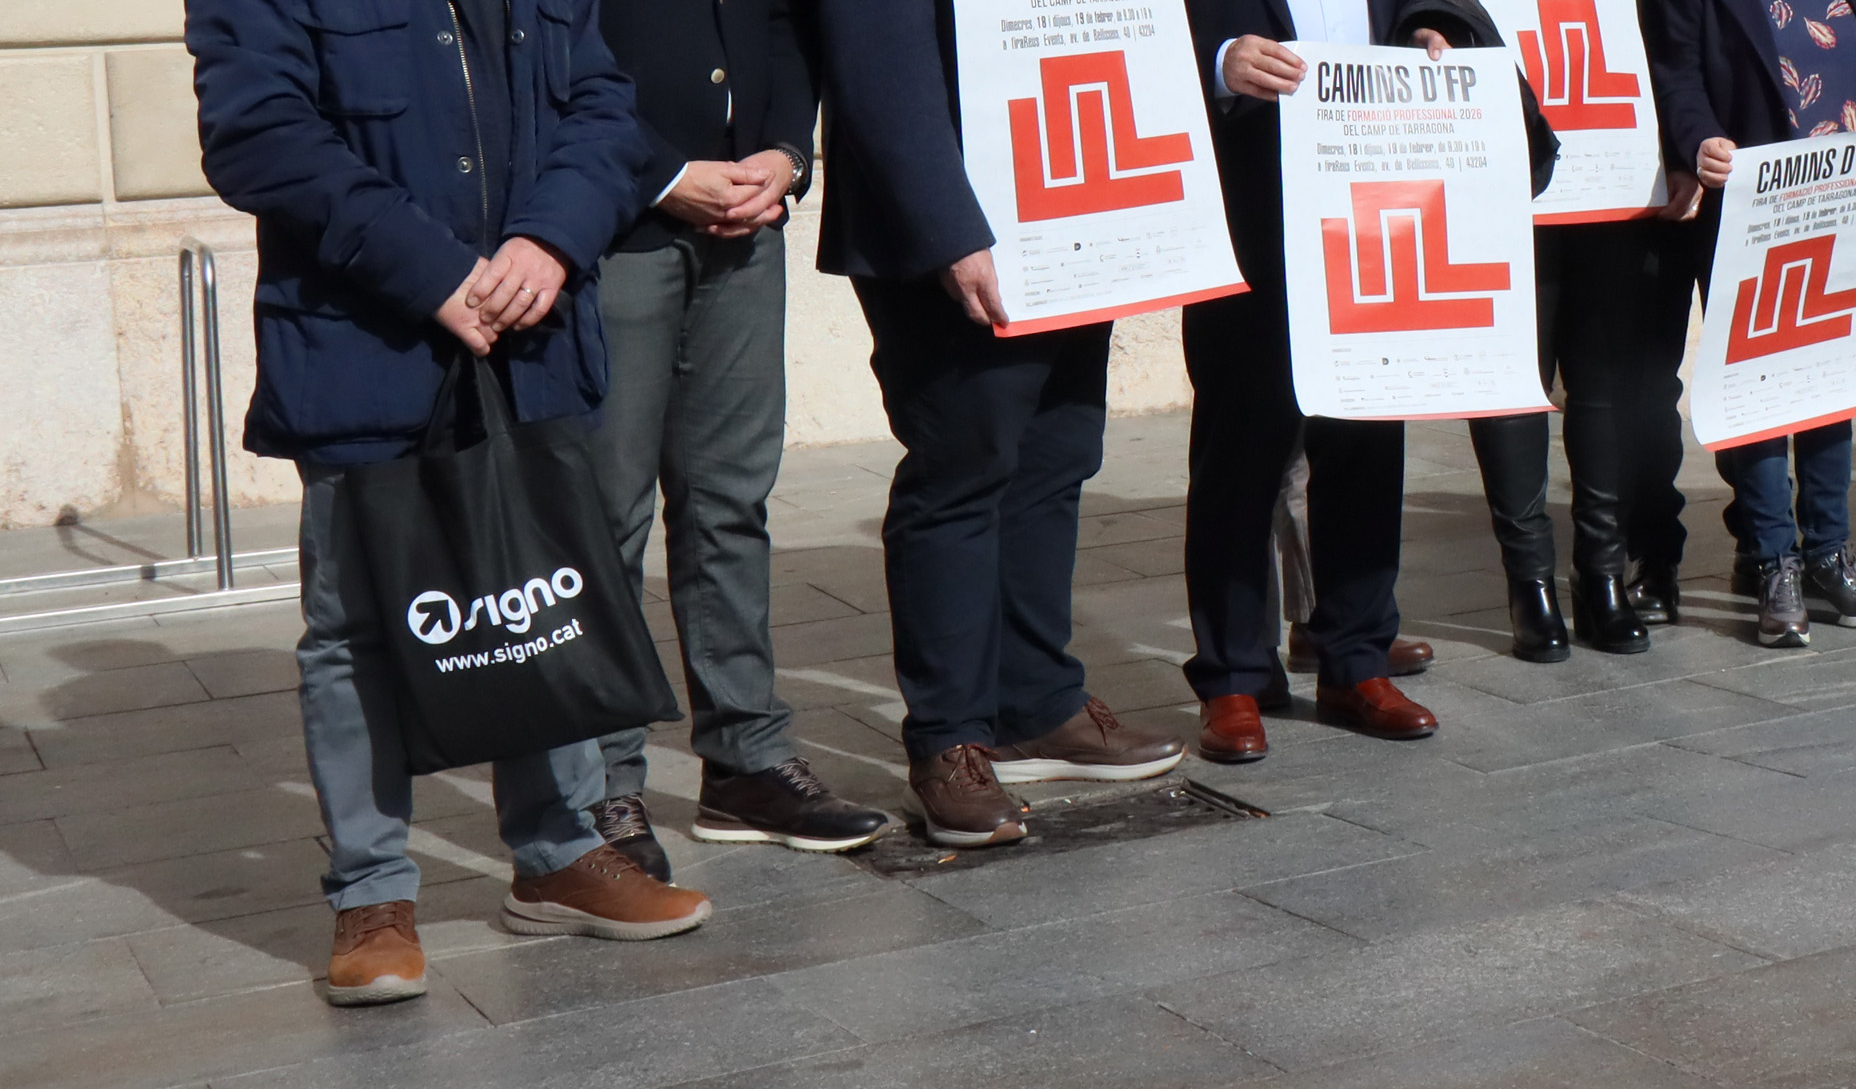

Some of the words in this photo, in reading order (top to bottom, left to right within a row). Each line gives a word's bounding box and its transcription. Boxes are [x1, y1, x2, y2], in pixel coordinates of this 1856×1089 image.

[1037, 16, 1046, 28] 18
[1076, 12, 1084, 25] 19
[1317, 61, 1412, 103] CAMINS
[1419, 65, 1476, 102] D'FP
[1317, 109, 1333, 121] FIRA
[1336, 110, 1345, 121] DE
[1348, 108, 1391, 121] FORMACIÓ
[1394, 108, 1457, 121] PROFESSIONAL
[1460, 108, 1482, 120] 2026
[1344, 124, 1359, 136] DEL
[1361, 124, 1386, 136] CAMP
[1389, 124, 1400, 135] DE
[1402, 123, 1455, 134] TARRAGONA
[1349, 143, 1357, 155] 18
[1757, 148, 1837, 194] CAMINS
[1752, 196, 1768, 207] FIRA
[1769, 195, 1779, 203] DE
[1773, 204, 1785, 213] DEL
[1787, 199, 1806, 210] CAMP
[1807, 197, 1816, 206] DE
[1818, 189, 1856, 203] TARRAGONA
[464, 567, 583, 633] signo
[436, 618, 583, 673] www.signo.cat
